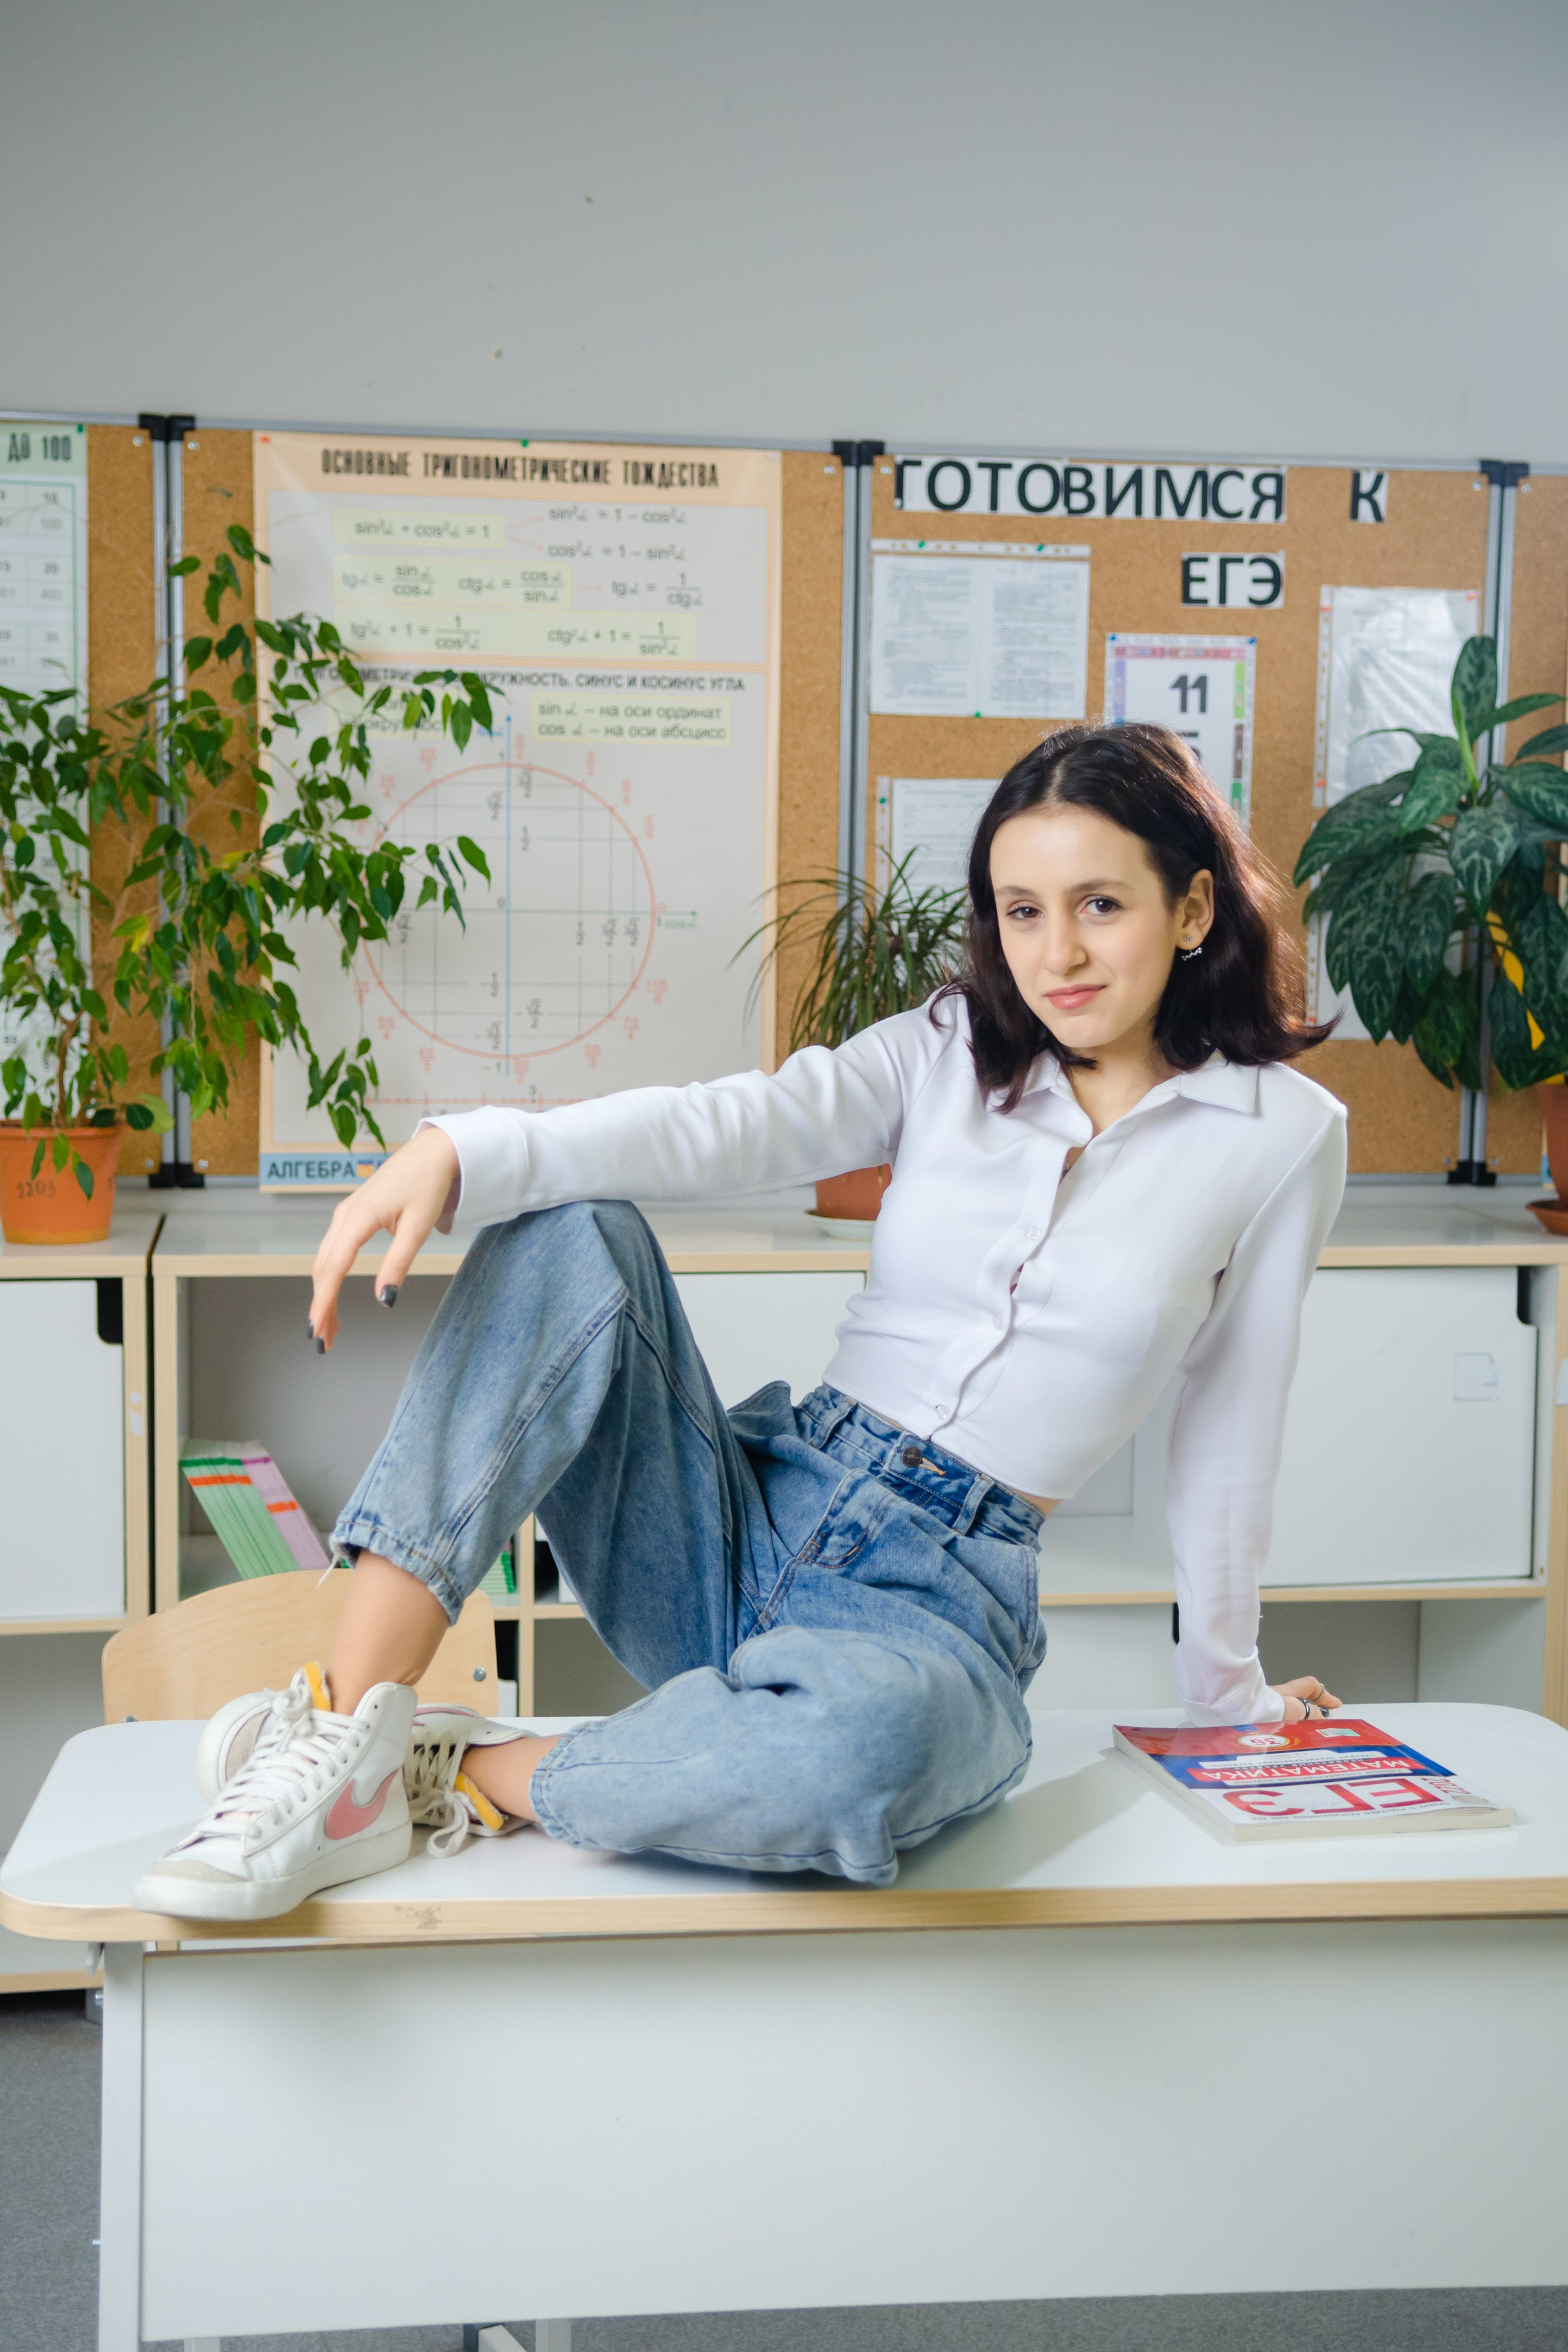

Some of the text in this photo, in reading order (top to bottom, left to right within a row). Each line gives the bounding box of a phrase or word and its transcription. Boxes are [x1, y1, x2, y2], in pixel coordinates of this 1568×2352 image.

[7, 432, 71, 461] ДО 100
[323, 448, 718, 489] ОСНОВНЫЕ ТРИГОНОМЕТРИЧЕСКИЕ ТОЖДЕСТВА
[895, 459, 1385, 522] ГОТОВИМСЯ К
[1182, 557, 1282, 606] ЕГЭ
[1170, 674, 1207, 713] 11
[268, 1159, 355, 1178] АЛГЕБРА
[1250, 1736, 1281, 1746] 36
[1201, 1760, 1410, 1779] МАТЕМАТИКА
[1223, 1778, 1444, 1816] ЕГЭ
